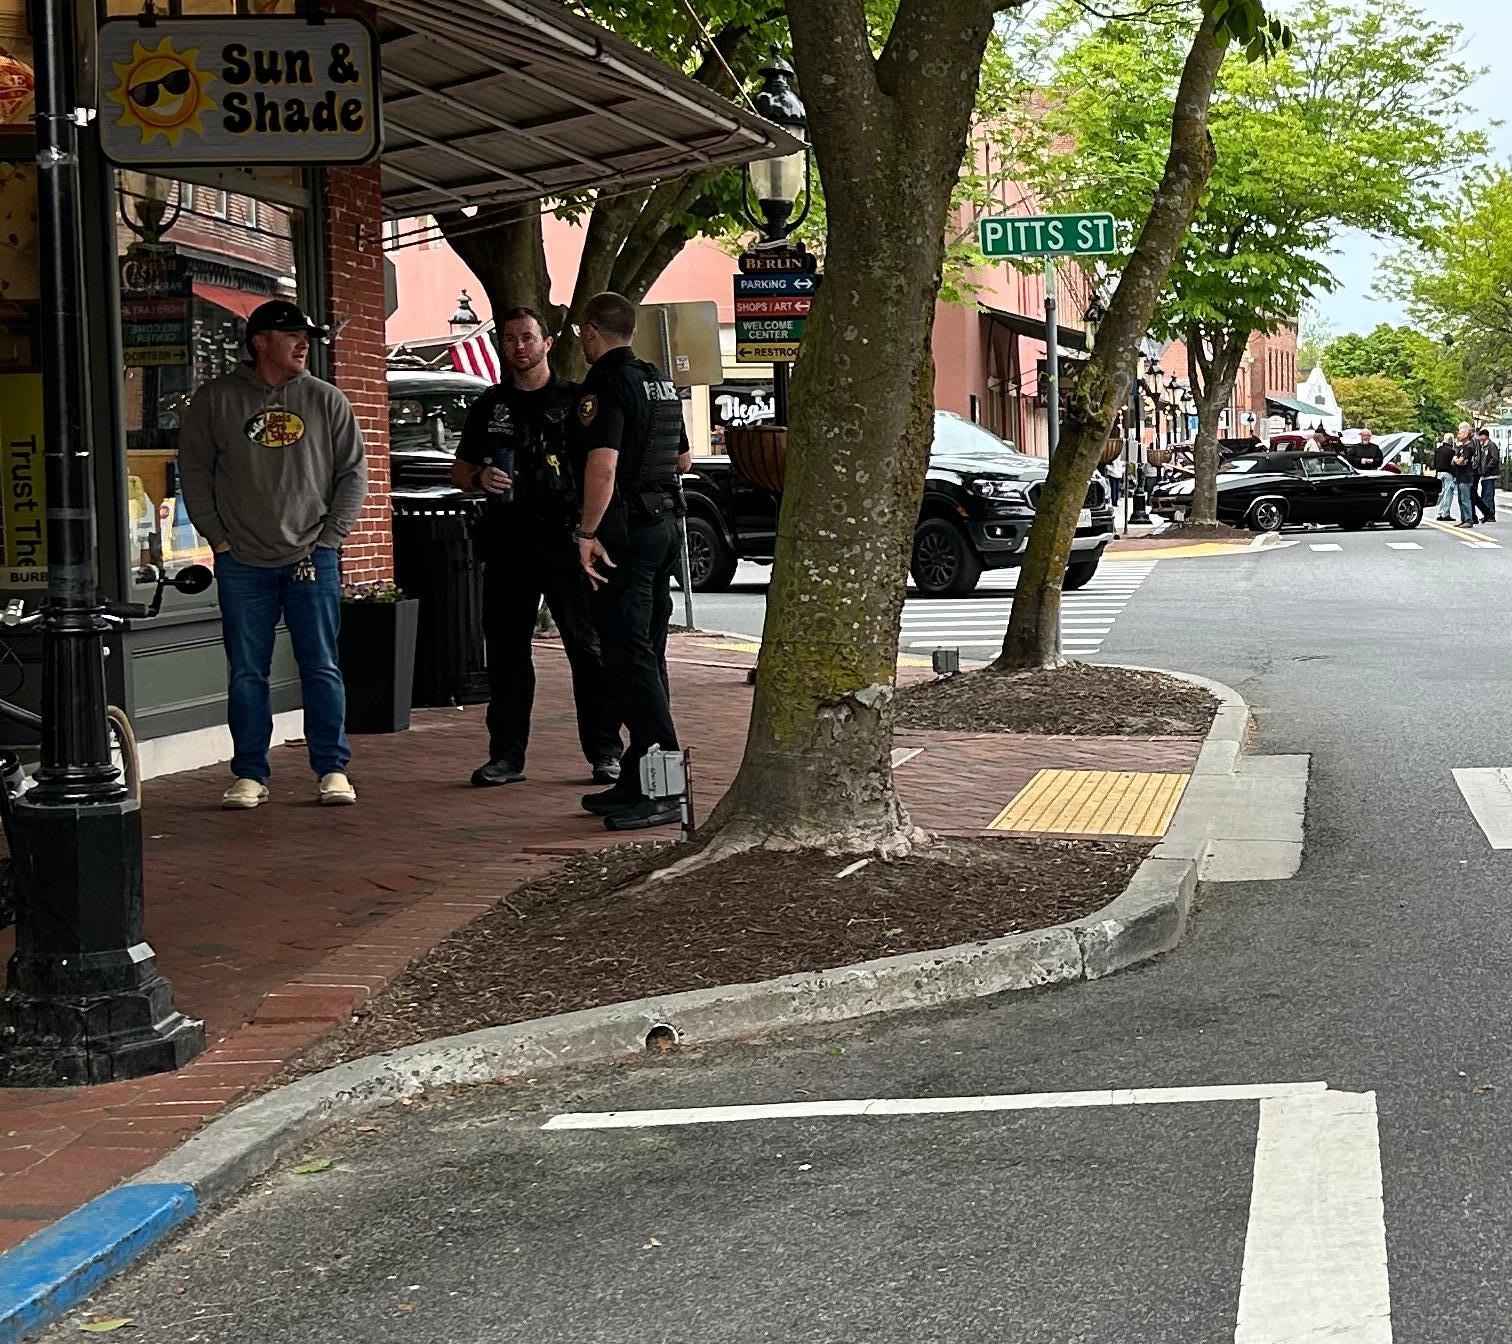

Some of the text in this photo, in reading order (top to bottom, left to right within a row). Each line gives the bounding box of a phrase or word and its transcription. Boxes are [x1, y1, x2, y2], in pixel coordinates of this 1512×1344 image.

[222, 43, 360, 85] Sun &
[222, 91, 364, 133] Shade
[985, 219, 1109, 252] PITTS ST
[745, 258, 802, 269] BERLIN
[740, 279, 787, 289] PARKING
[736, 302, 768, 312] SHOPS
[774, 302, 792, 311] ART
[743, 320, 793, 330] WELCOME
[748, 330, 788, 339] CENTER
[11, 434, 38, 512] Trust
